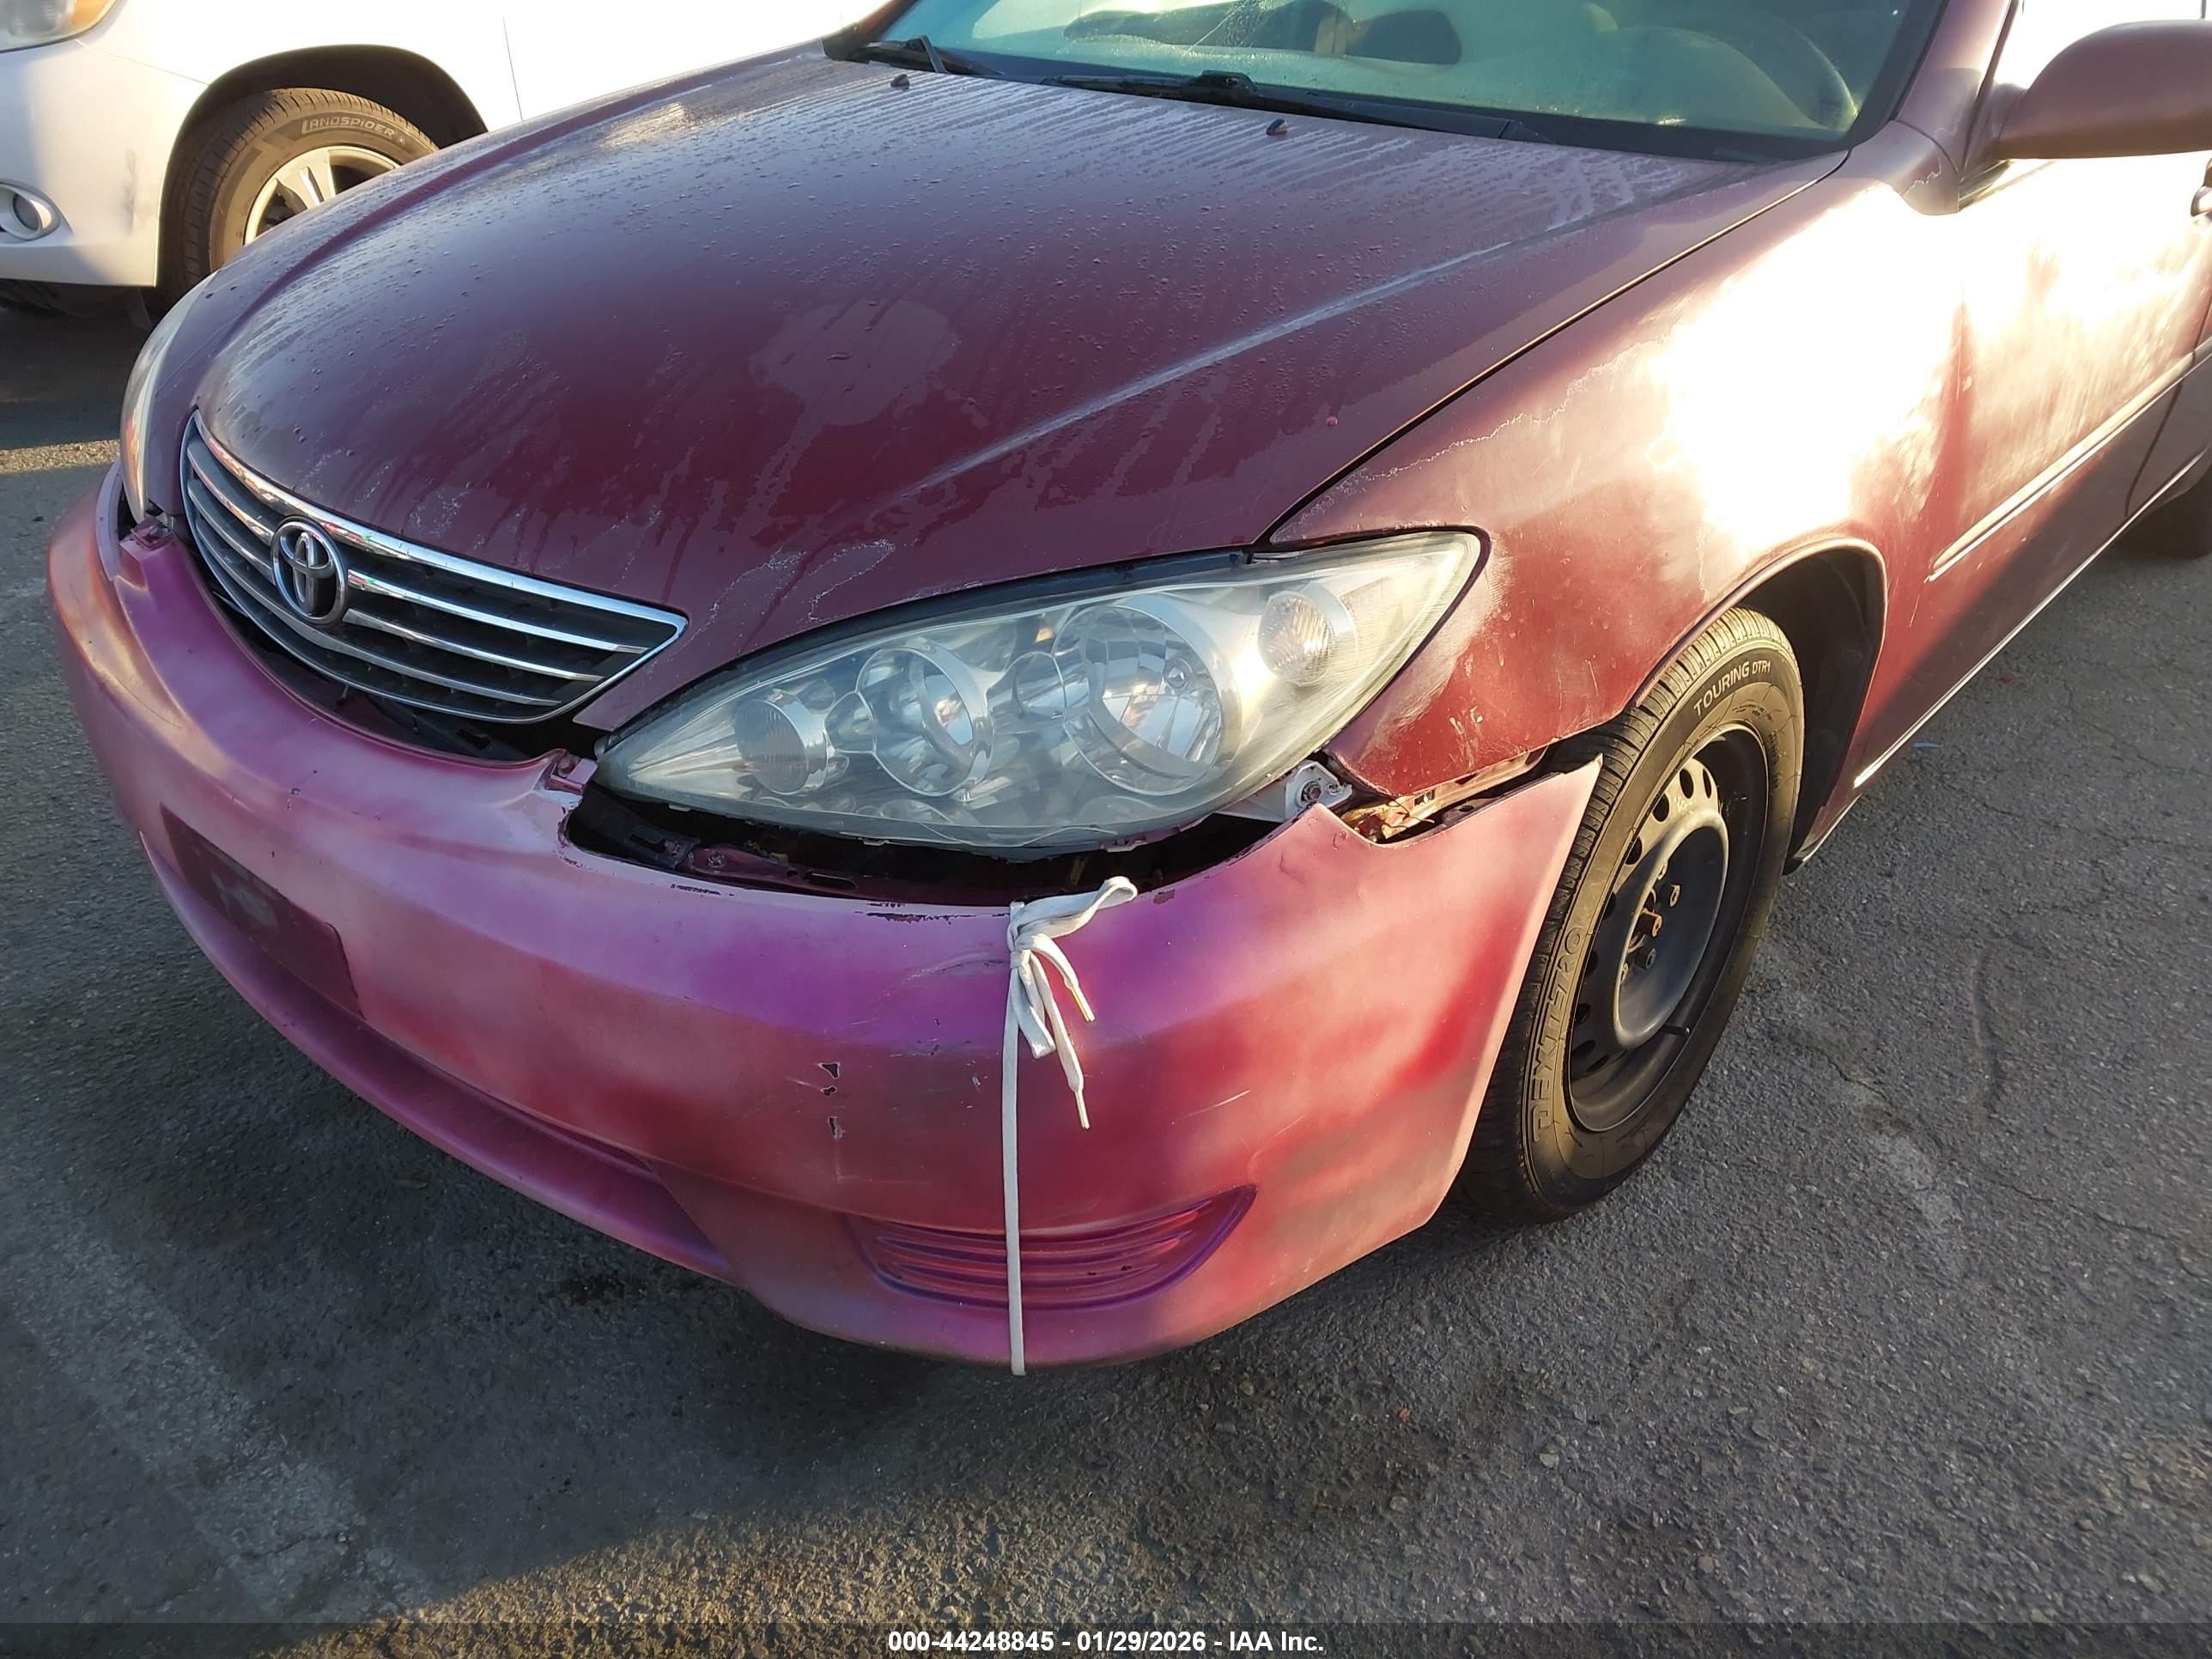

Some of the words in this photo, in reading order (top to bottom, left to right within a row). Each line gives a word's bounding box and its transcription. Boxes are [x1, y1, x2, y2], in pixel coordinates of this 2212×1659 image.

[301, 116, 396, 137] LANDSPIDER
[1693, 660, 1750, 718] TOURING
[1751, 659, 1771, 675] DTR1
[1531, 926, 1582, 1143] DEXTERO
